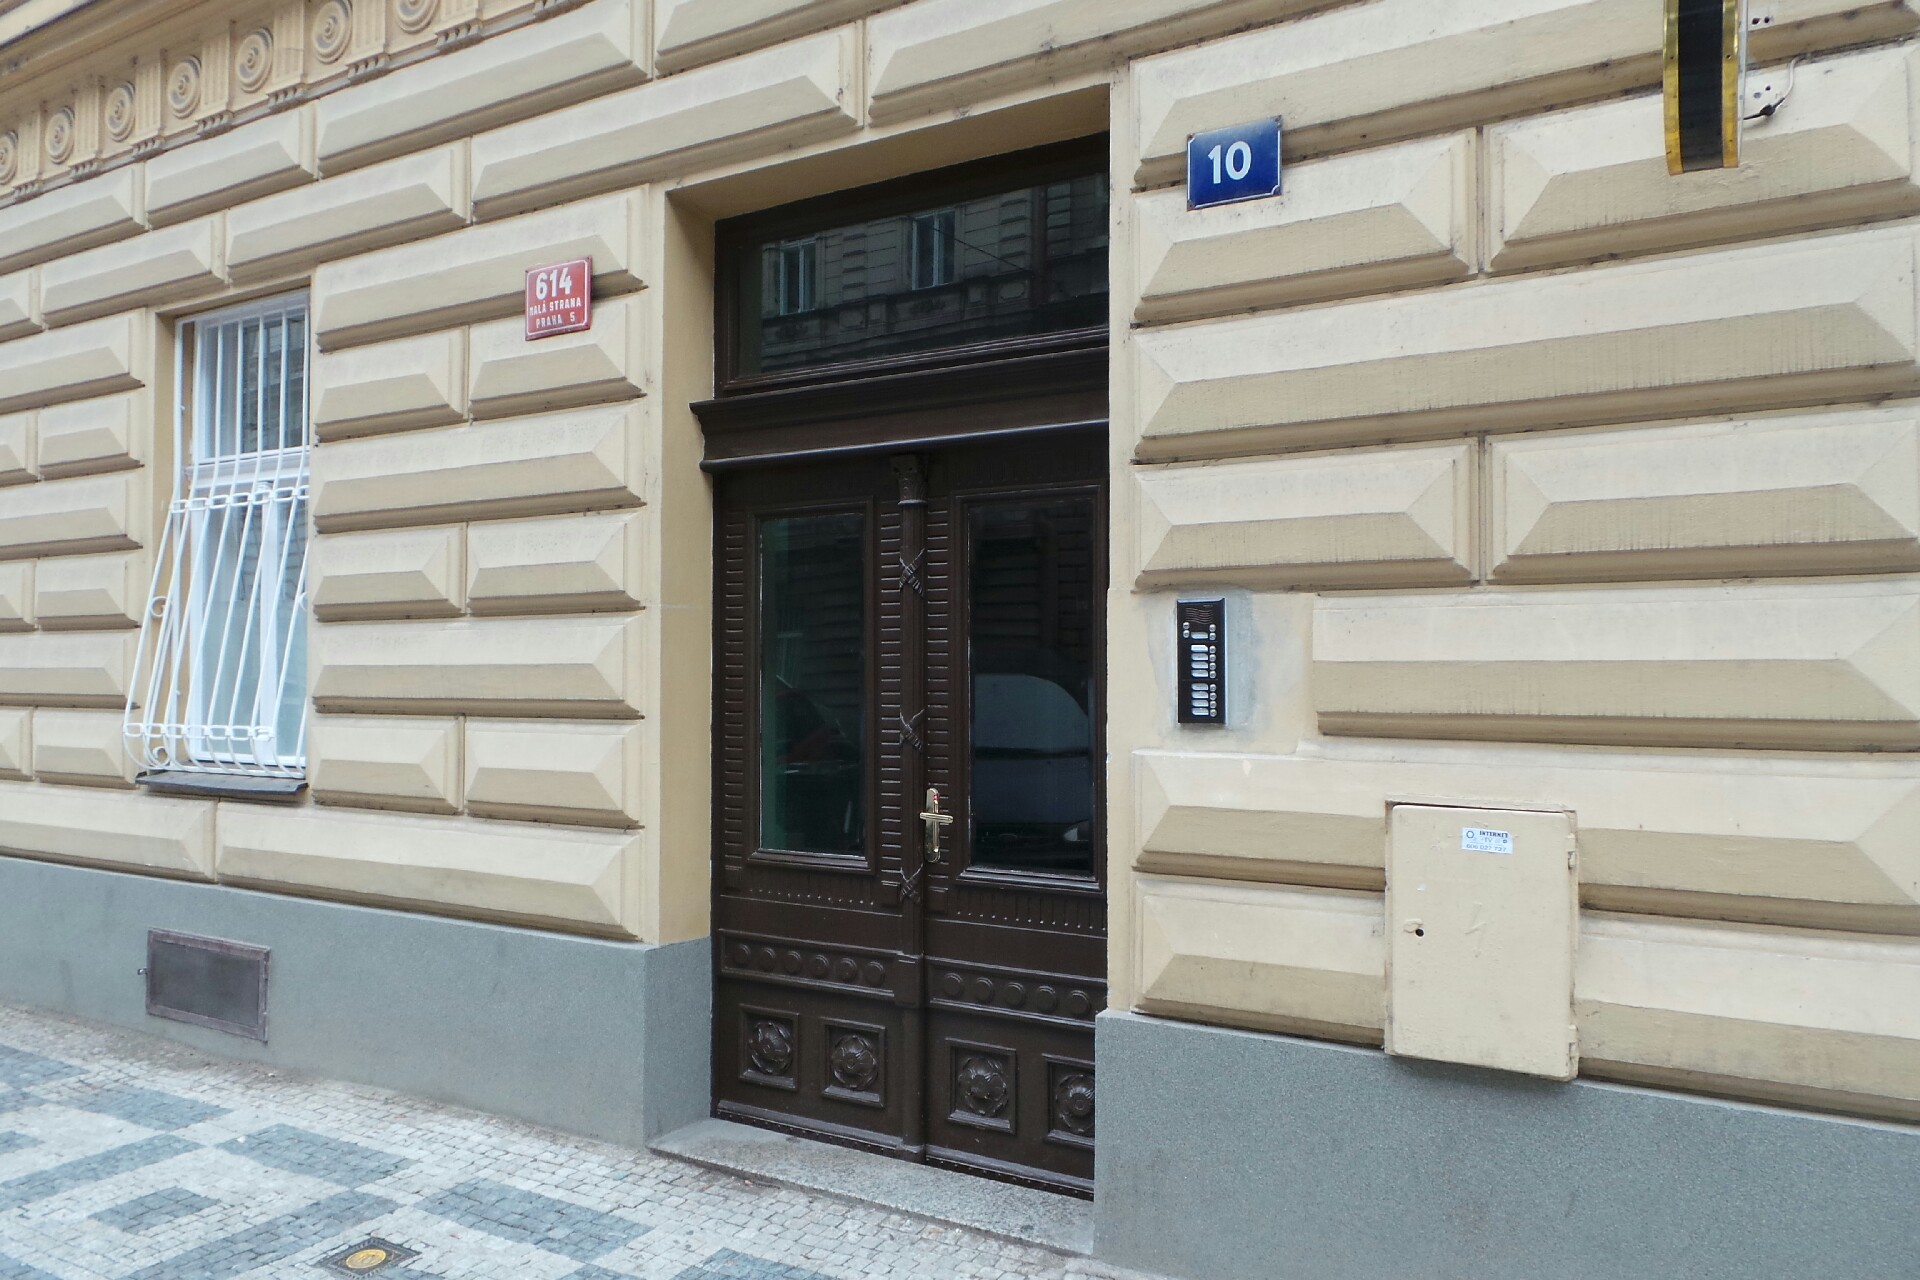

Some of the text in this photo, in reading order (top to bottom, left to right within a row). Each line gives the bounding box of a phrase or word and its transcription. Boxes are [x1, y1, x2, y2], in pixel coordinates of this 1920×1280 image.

[1208, 140, 1252, 184] 10
[536, 267, 572, 300] 614
[529, 297, 582, 316] MALÁ STRANA
[535, 311, 576, 329] PRAHA 5
